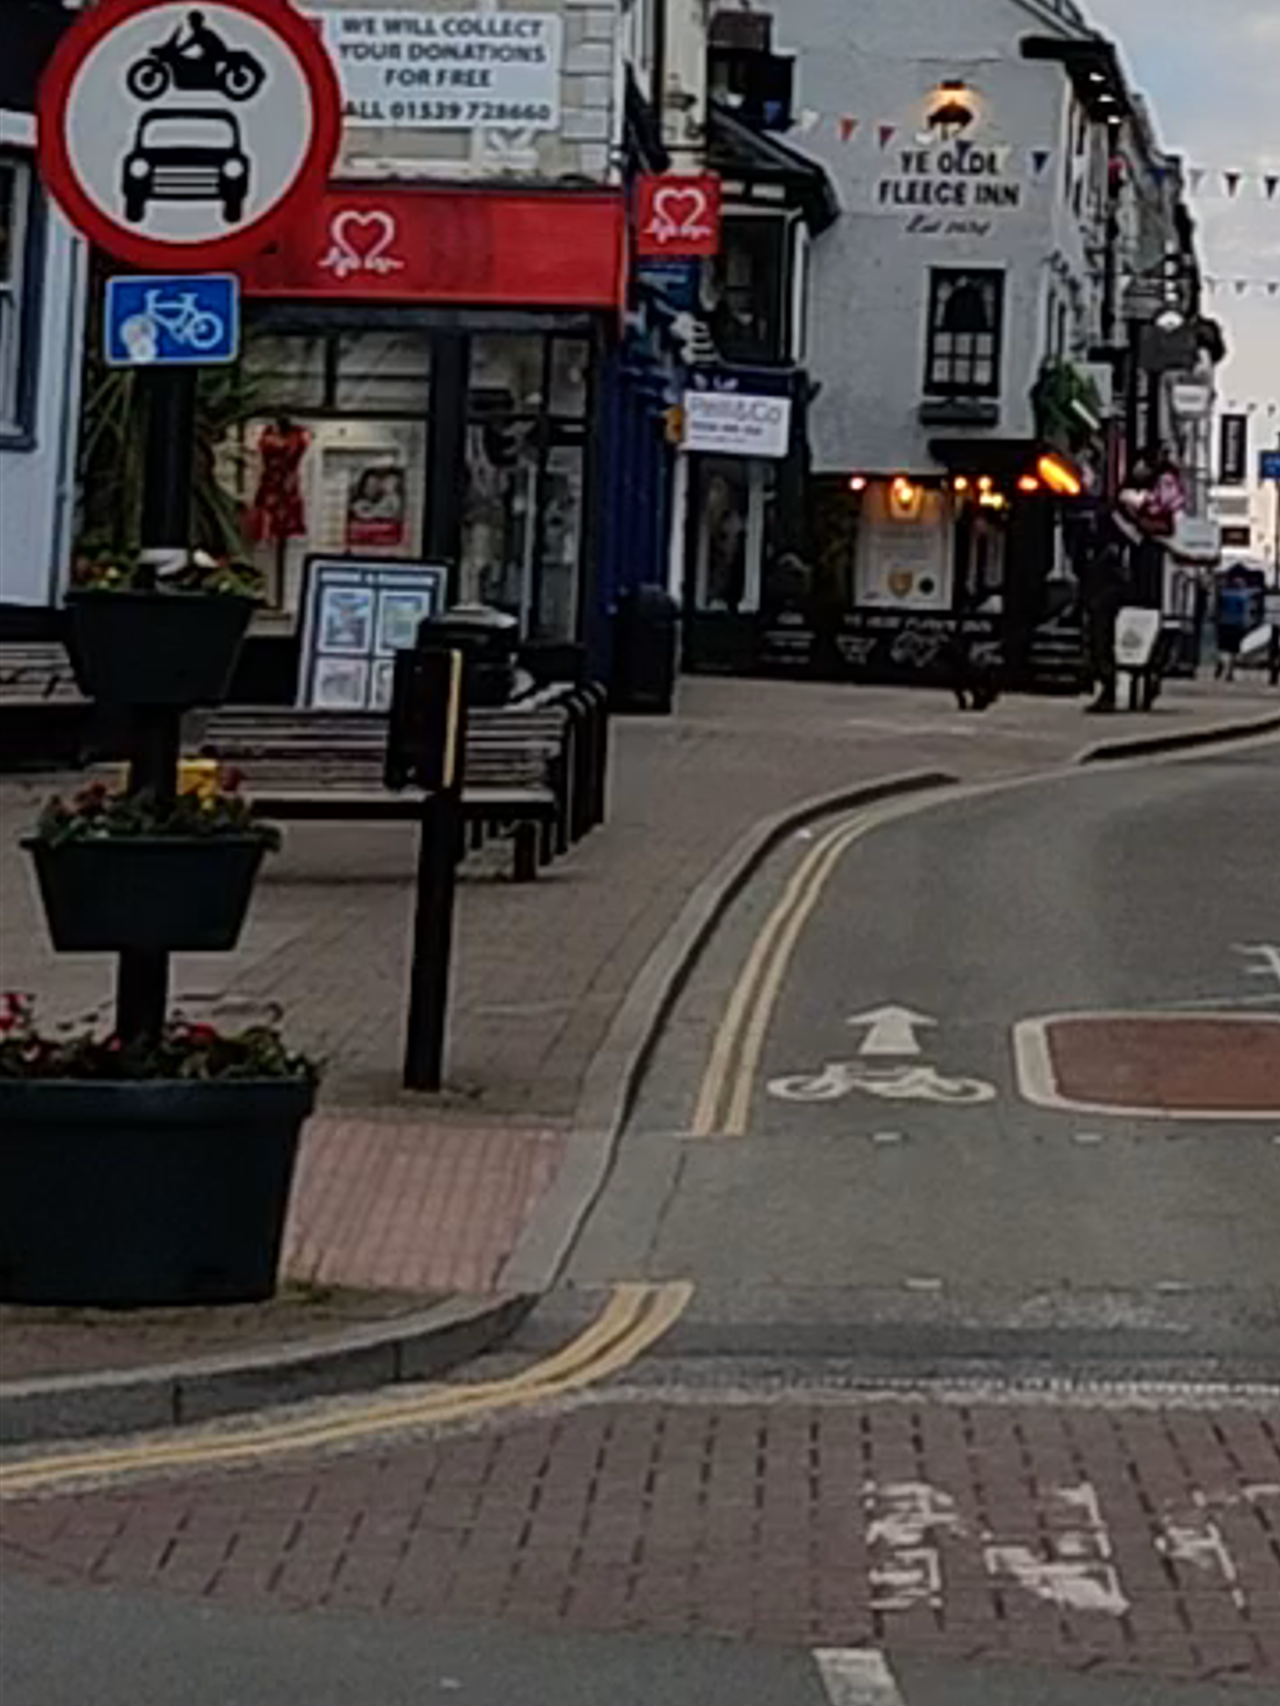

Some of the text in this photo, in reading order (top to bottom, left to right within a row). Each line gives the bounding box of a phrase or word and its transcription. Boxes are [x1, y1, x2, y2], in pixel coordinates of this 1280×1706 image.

[341, 17, 544, 37] WE WILL COLLECT
[339, 42, 547, 63] YOUR DONATIONS
[384, 67, 492, 88] FOR FREE
[345, 100, 385, 121] ALL
[900, 150, 931, 175] YE
[879, 178, 1020, 207] FLEECE INN
